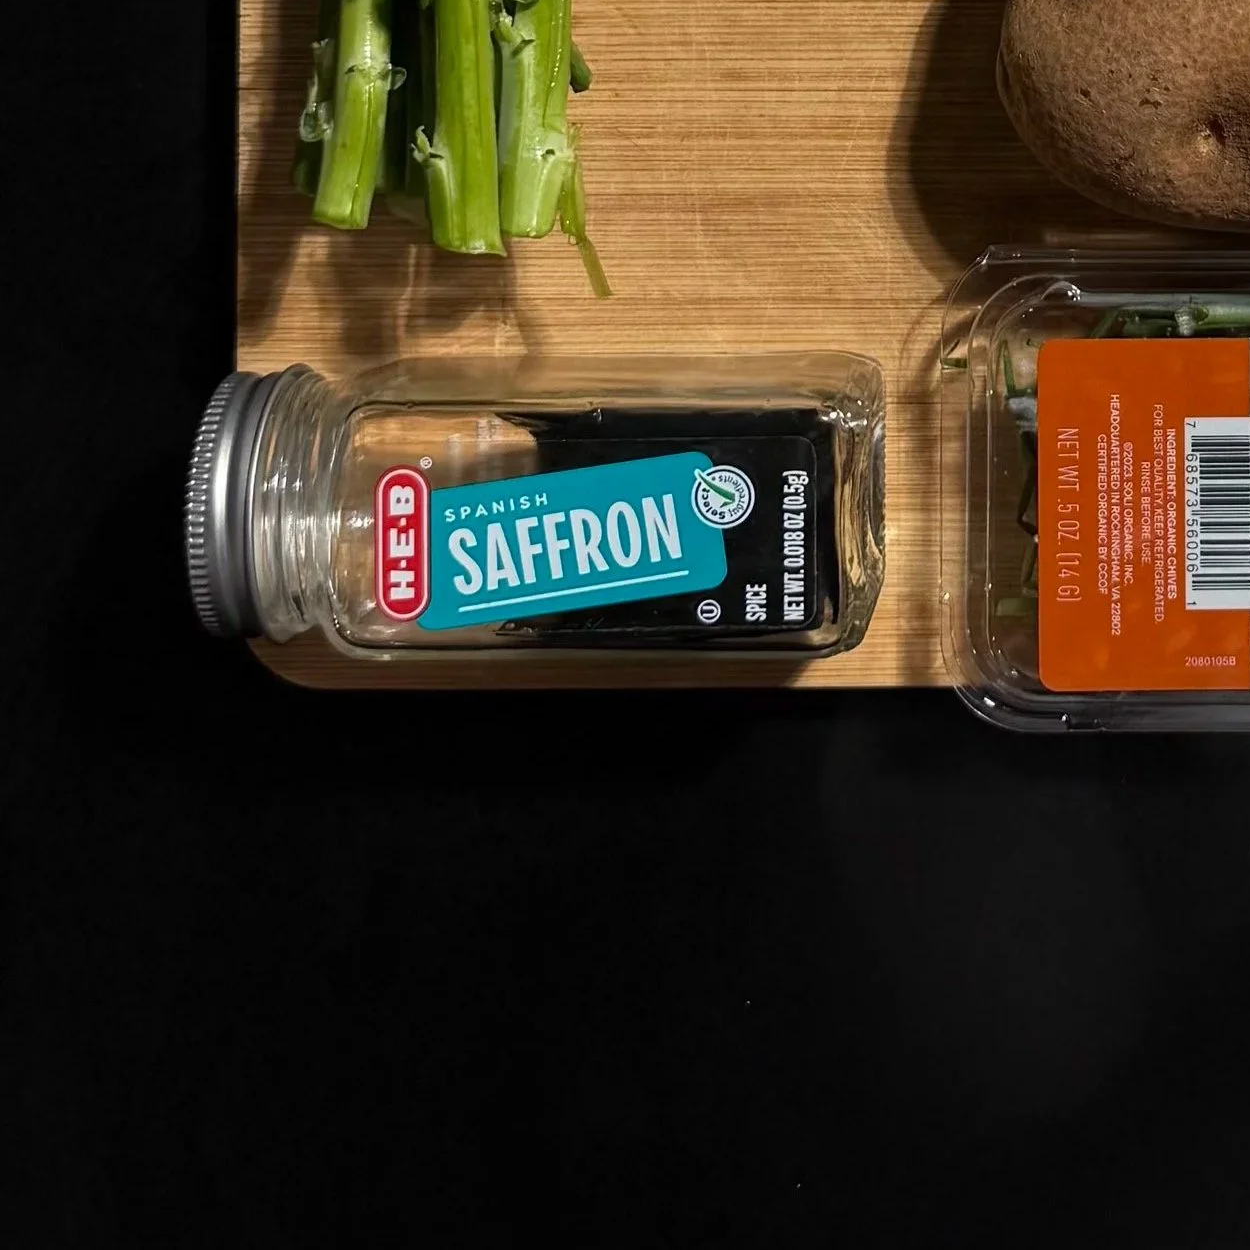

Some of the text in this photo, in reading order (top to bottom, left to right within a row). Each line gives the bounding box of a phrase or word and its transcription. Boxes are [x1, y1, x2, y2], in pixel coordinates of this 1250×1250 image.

[1153, 404, 1164, 426] FOR
[1186, 420, 1196, 428] 7
[1110, 394, 1120, 490] HEADQUARTERED
[1153, 429, 1164, 456] BEST
[702, 474, 746, 520] Select Ingredients
[1110, 492, 1120, 503] IN
[1123, 482, 1134, 506] SOLI
[1186, 454, 1198, 508] 68573
[444, 492, 548, 522] SPANISH
[1056, 428, 1082, 602] NET WT .5 OZ. (14 G)
[1097, 434, 1108, 595] CERTIFIED ORGANIC BY CCOF
[1140, 461, 1151, 566] RINSE BEFORE USE.
[1154, 508, 1164, 537] KEEP
[1166, 428, 1178, 600] INGREDIENT: ORGANIC CHIVES
[390, 484, 415, 601] H-E-B
[448, 492, 683, 596] SAFFRON
[782, 470, 809, 620] NET WT. 0.018 OZ (0.5g)
[1186, 518, 1198, 572] 56006
[1110, 586, 1120, 600] VA
[1124, 564, 1134, 586] INC.
[1154, 538, 1164, 624] REFRIGERATED.
[745, 584, 767, 622] SPICE
[1110, 602, 1120, 636] 22802
